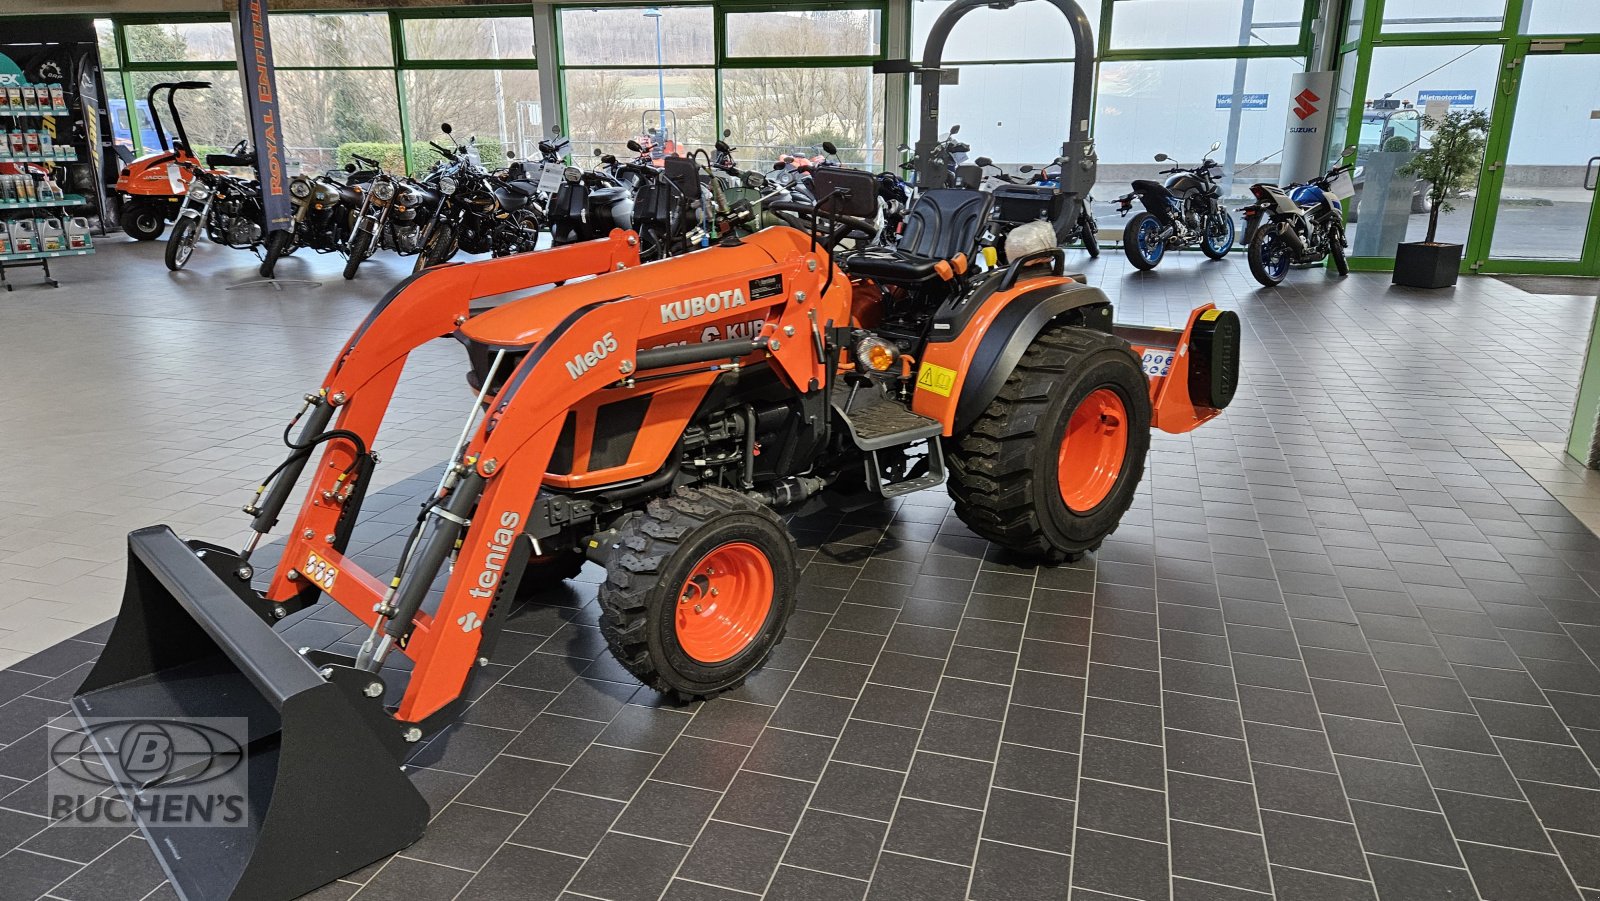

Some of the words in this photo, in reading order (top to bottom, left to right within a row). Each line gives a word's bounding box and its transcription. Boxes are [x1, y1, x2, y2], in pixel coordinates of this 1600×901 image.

[1420, 93, 1474, 101] Mietmotorräder
[263, 109, 283, 196] ROYAL
[660, 287, 747, 325] KUBOTA
[565, 331, 618, 380] Me05
[469, 511, 520, 598] tenias
